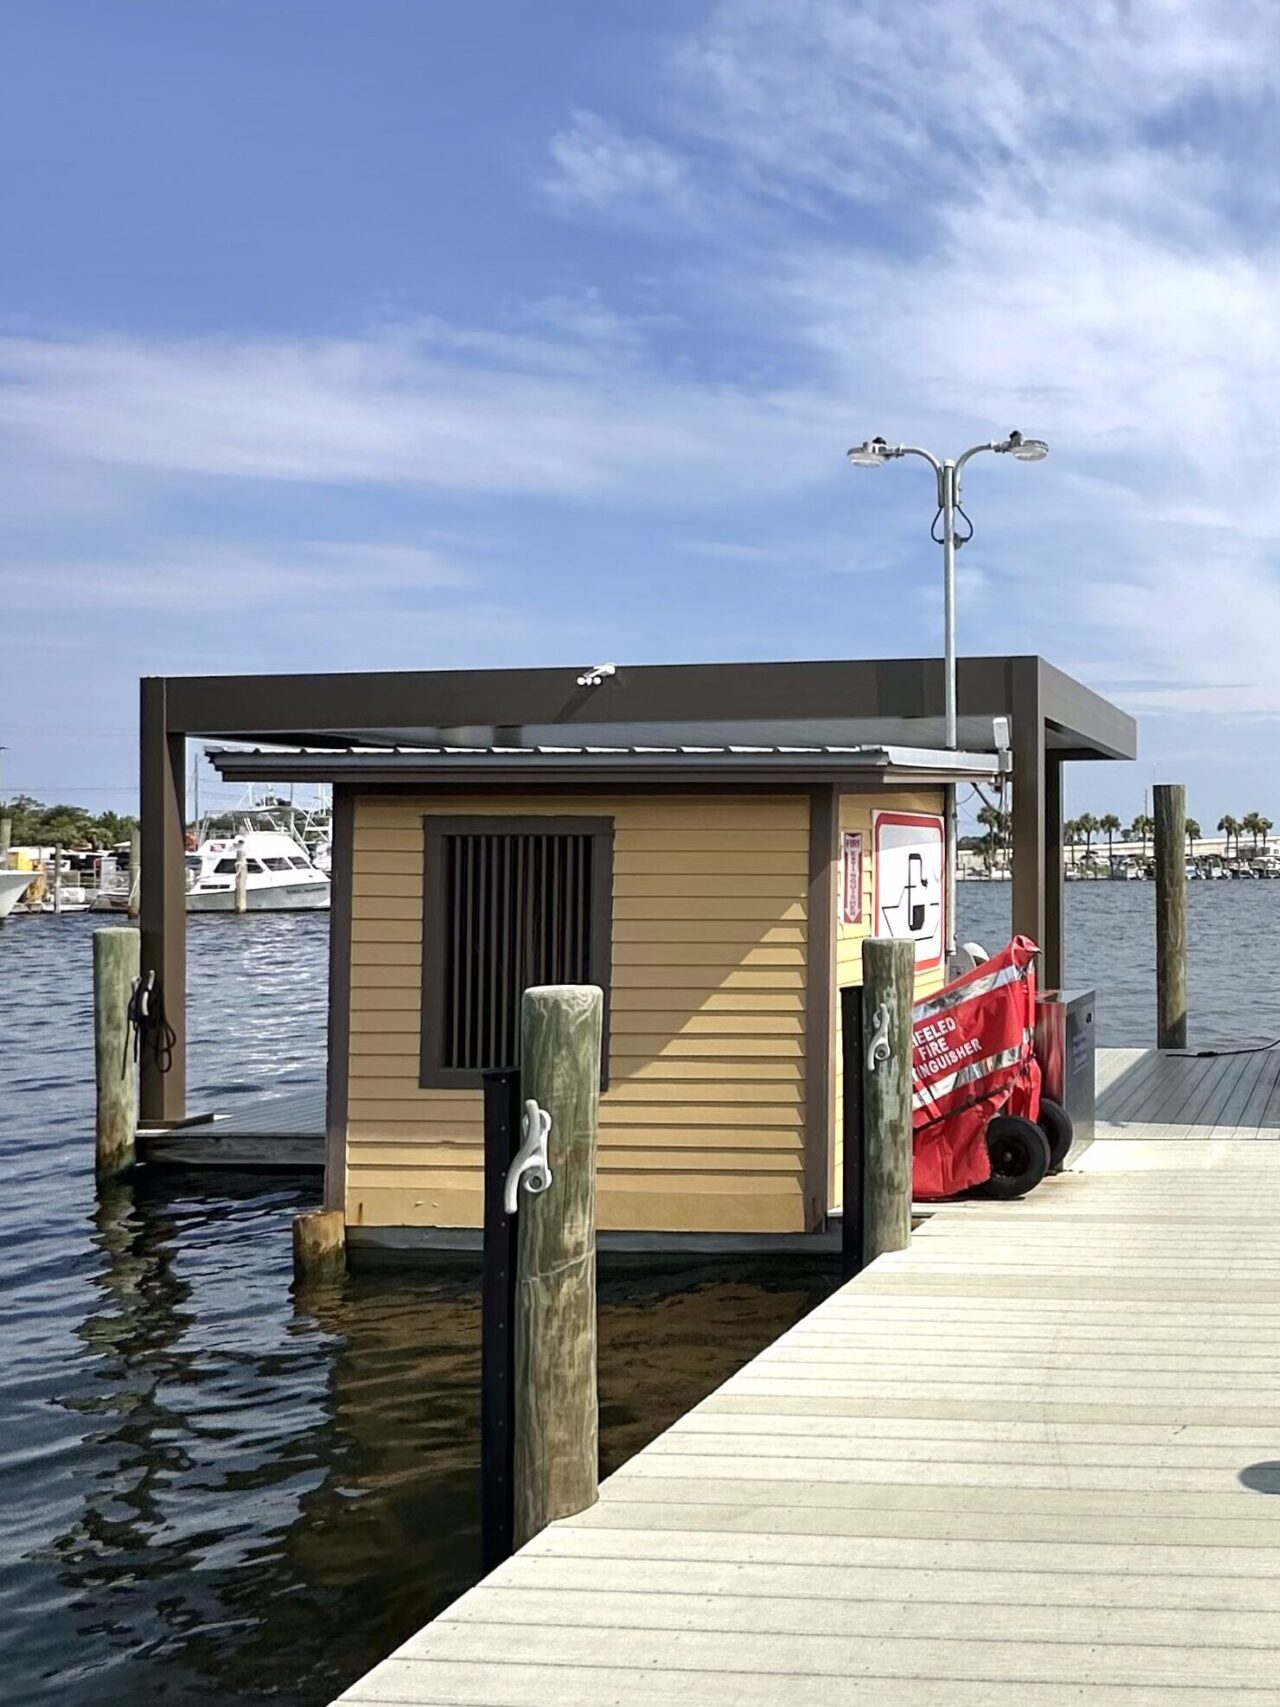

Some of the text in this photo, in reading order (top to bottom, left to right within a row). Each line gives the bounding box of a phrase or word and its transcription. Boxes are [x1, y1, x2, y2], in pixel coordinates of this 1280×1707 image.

[846, 839, 860, 848] FIRE
[912, 1017, 956, 1047] EELED
[912, 1038, 982, 1080] INGUISHER
[918, 1037, 950, 1061] FIRE
